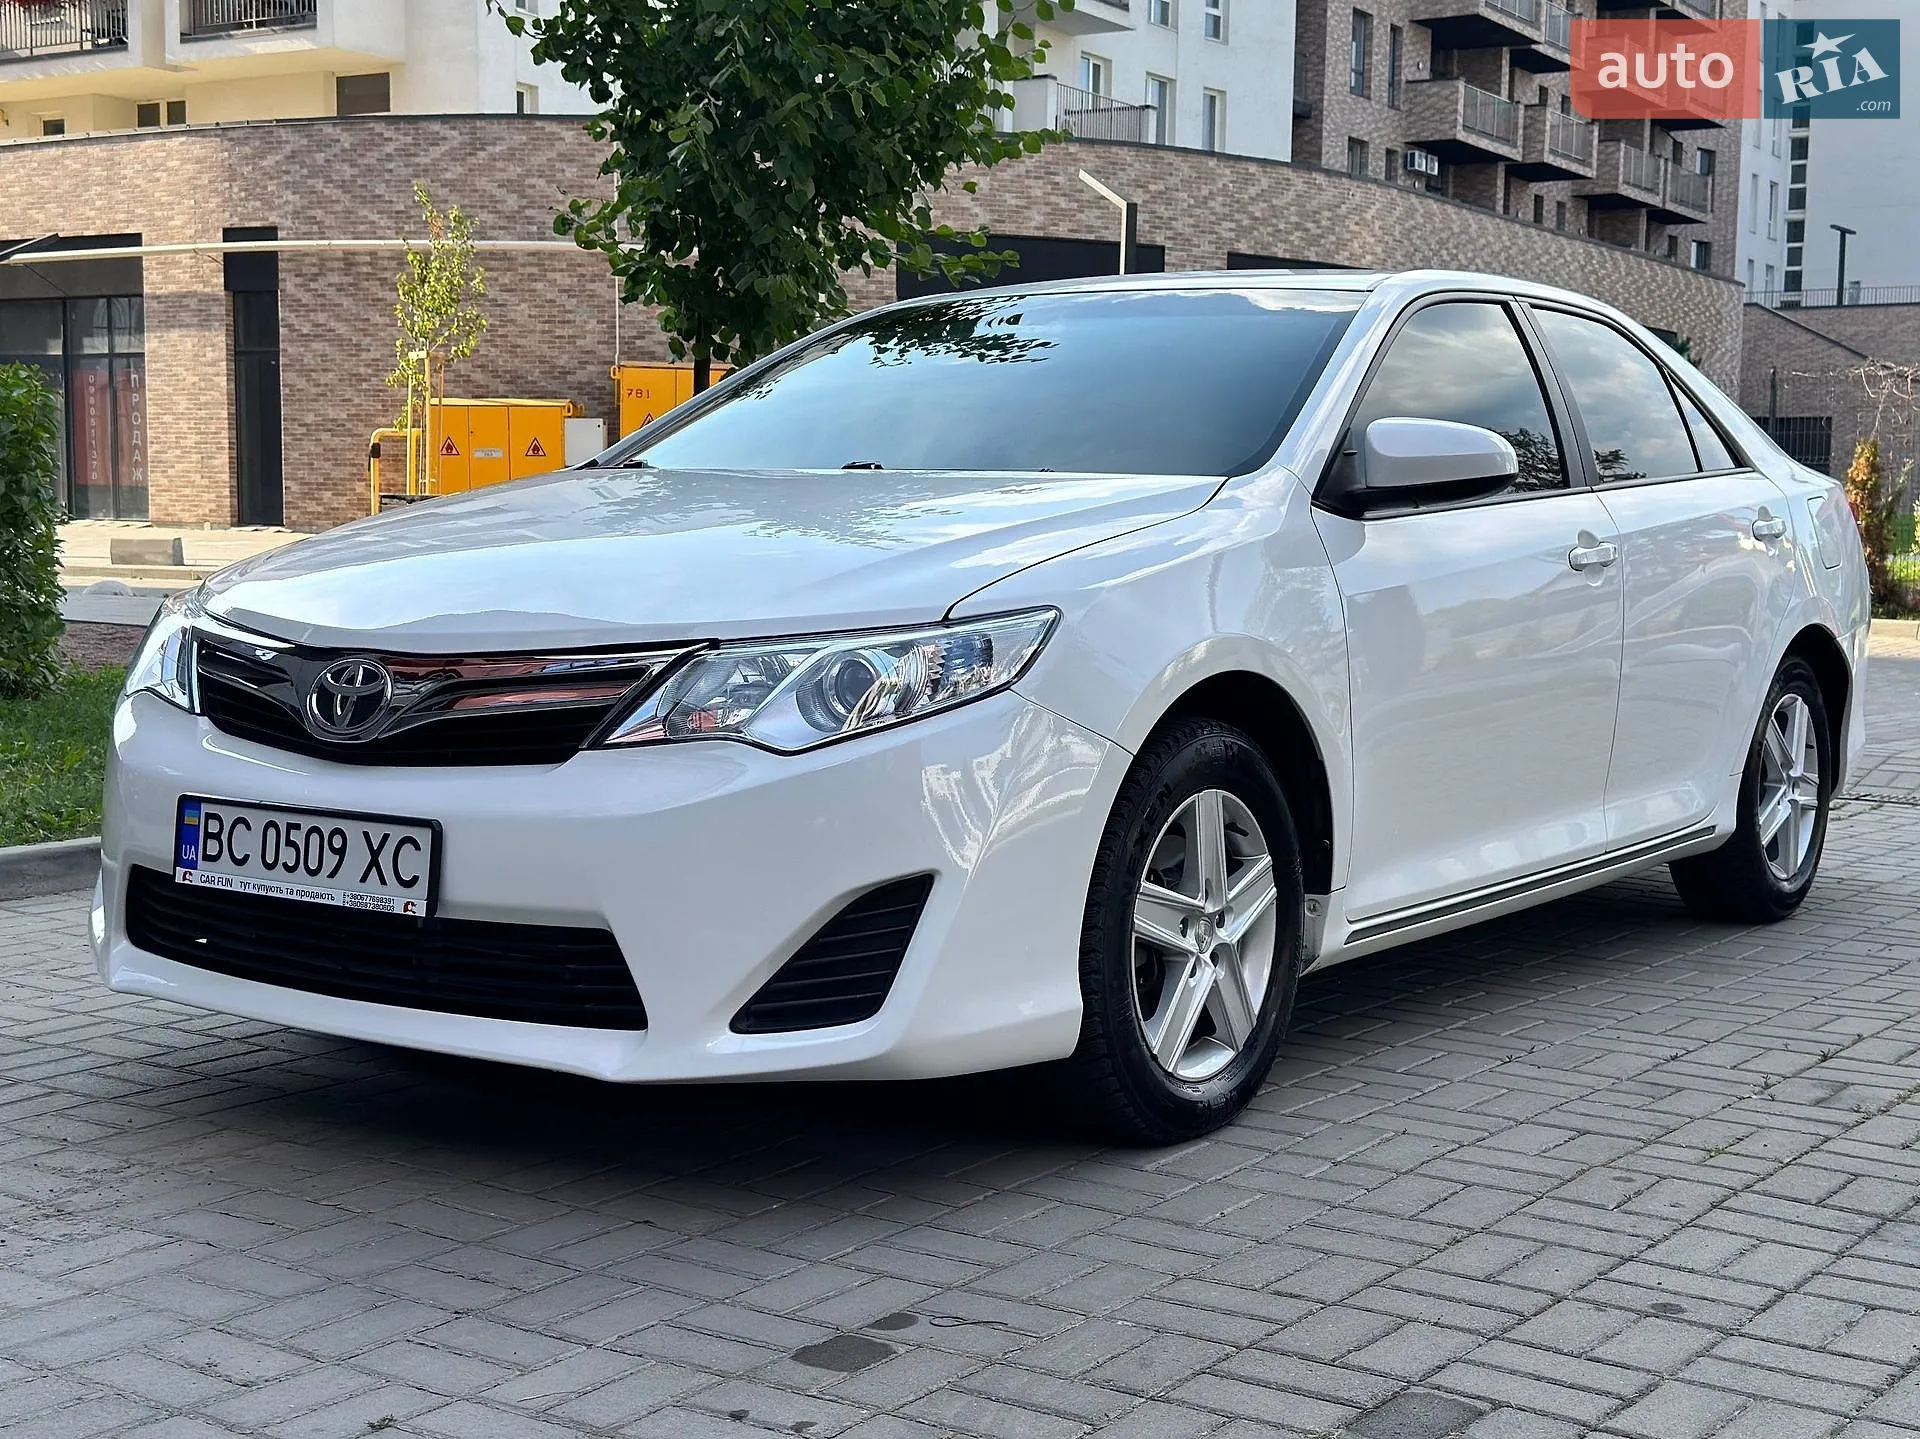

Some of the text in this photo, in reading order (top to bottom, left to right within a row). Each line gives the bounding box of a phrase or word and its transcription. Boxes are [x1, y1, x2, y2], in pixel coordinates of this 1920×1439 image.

[626, 388, 650, 399] 781
[130, 374, 144, 481] ПРОДАЖ
[182, 844, 196, 860] UA
[201, 811, 422, 889] BC 0509 XC
[199, 873, 336, 902] CAR FUN тут купують та продають
